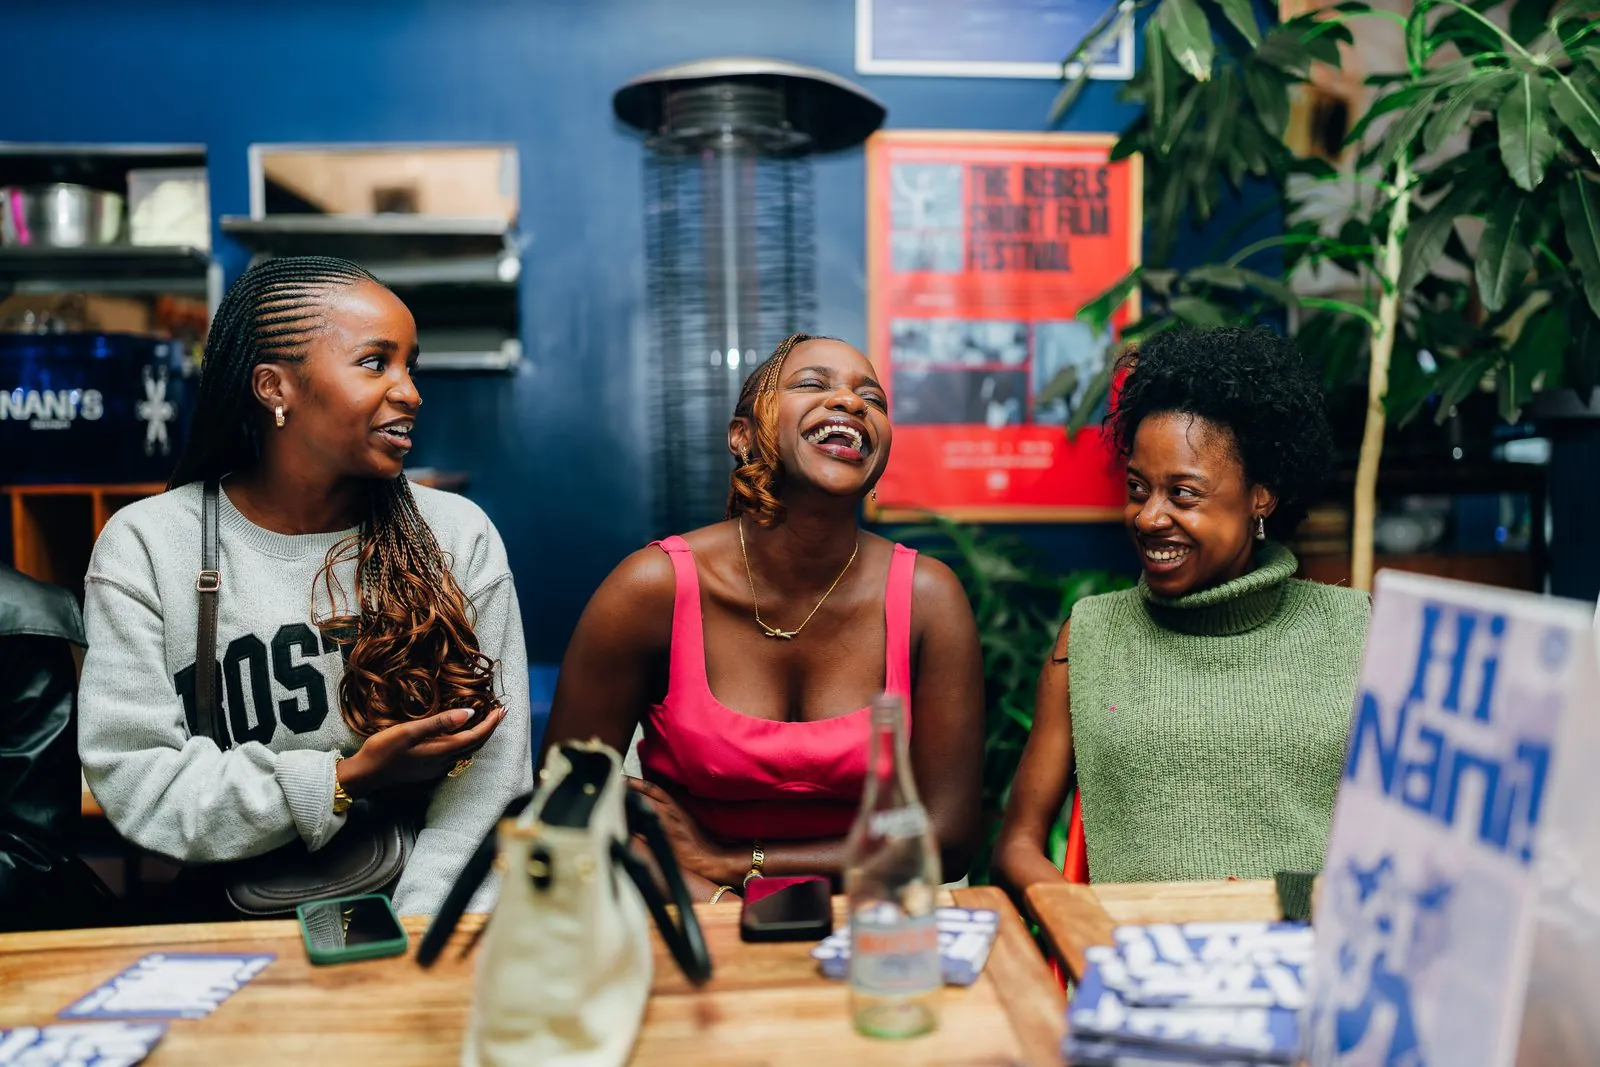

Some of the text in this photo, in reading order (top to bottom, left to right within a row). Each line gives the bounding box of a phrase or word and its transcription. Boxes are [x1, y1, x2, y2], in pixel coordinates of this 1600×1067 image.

[969, 165, 1109, 199] THE REBELS
[969, 202, 1109, 236] SHORT FILM
[968, 240, 1072, 271] FESTIVAL
[1409, 604, 1509, 724] Hi
[173, 621, 358, 752] OS
